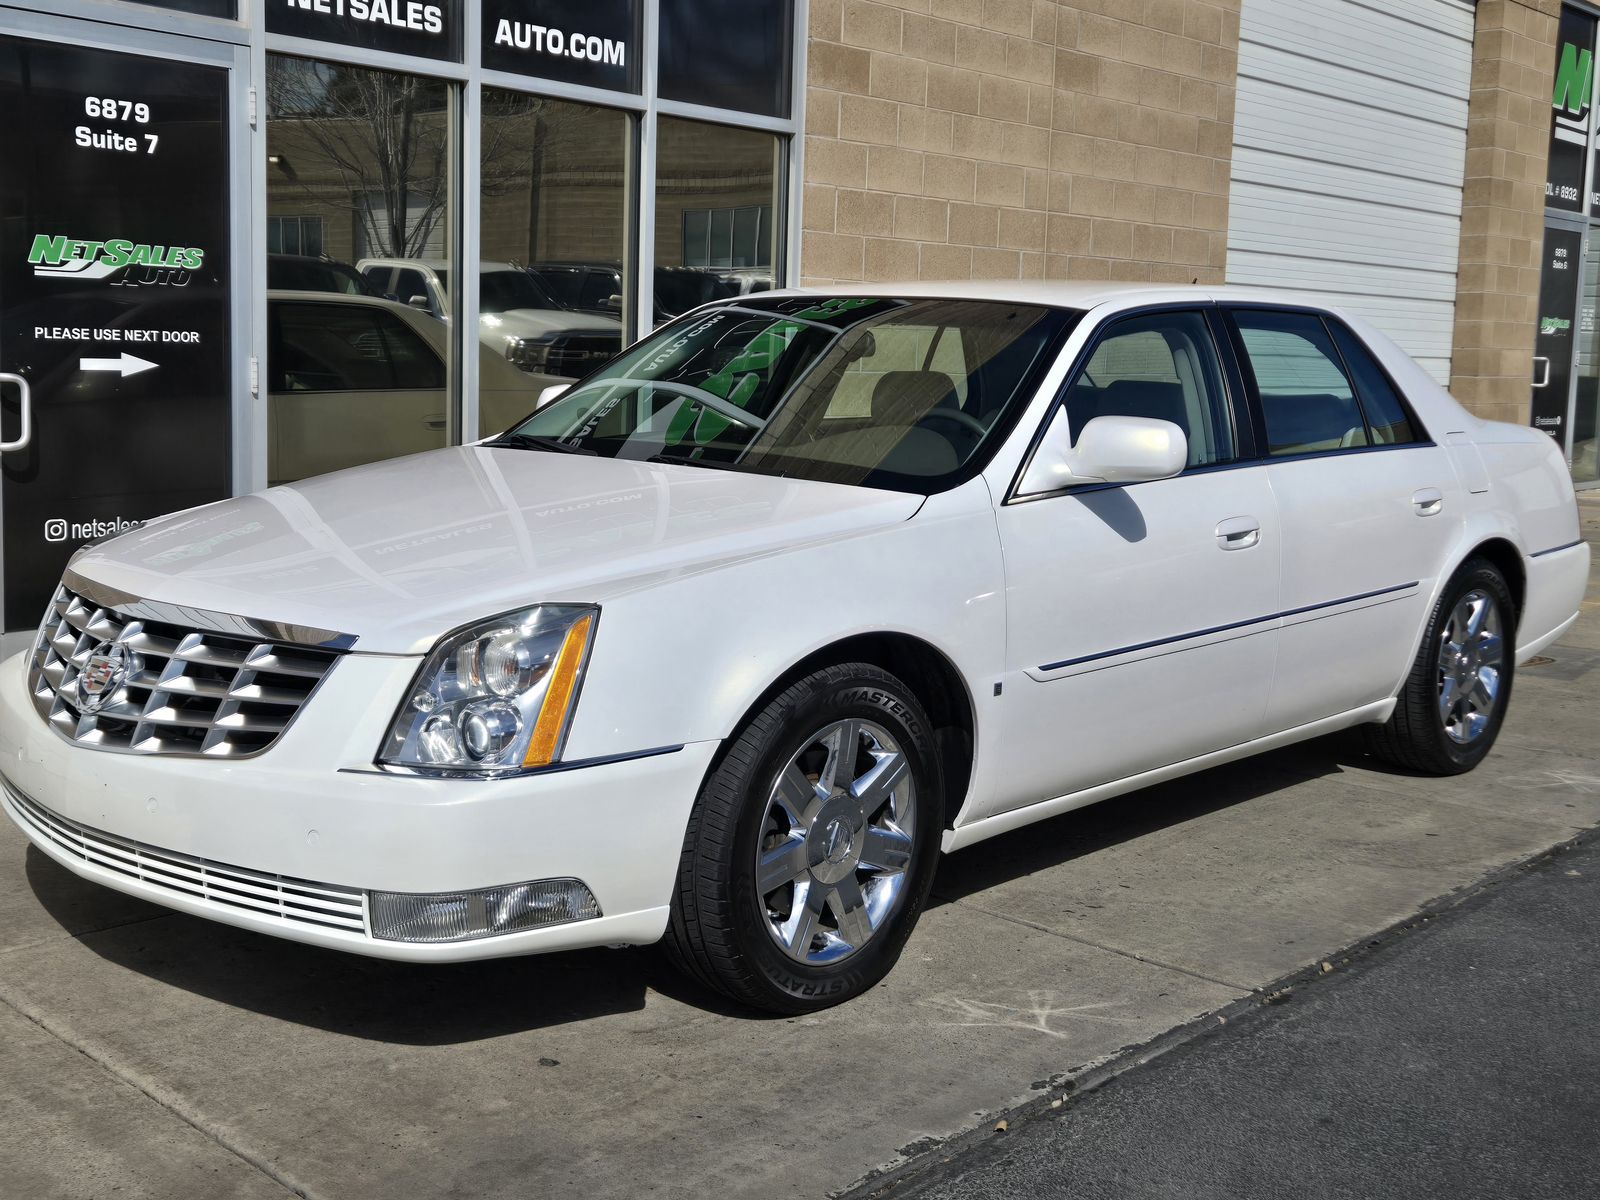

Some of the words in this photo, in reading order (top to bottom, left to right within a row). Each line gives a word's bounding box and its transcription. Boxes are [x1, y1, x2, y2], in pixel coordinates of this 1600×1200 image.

[494, 18, 626, 67] AUTO.COM
[1552, 41, 1592, 115] N
[84, 95, 151, 124] 6879
[74, 125, 138, 153] Suite
[144, 133, 159, 154] 7
[27, 233, 205, 270] NETSALES
[109, 266, 193, 287] AUTO
[34, 326, 91, 341] PLEASE
[93, 328, 121, 342] USE
[124, 329, 159, 343] NEXT
[161, 331, 201, 344] DOOR
[71, 516, 149, 540] netsale
[760, 958, 844, 997] STRATU
